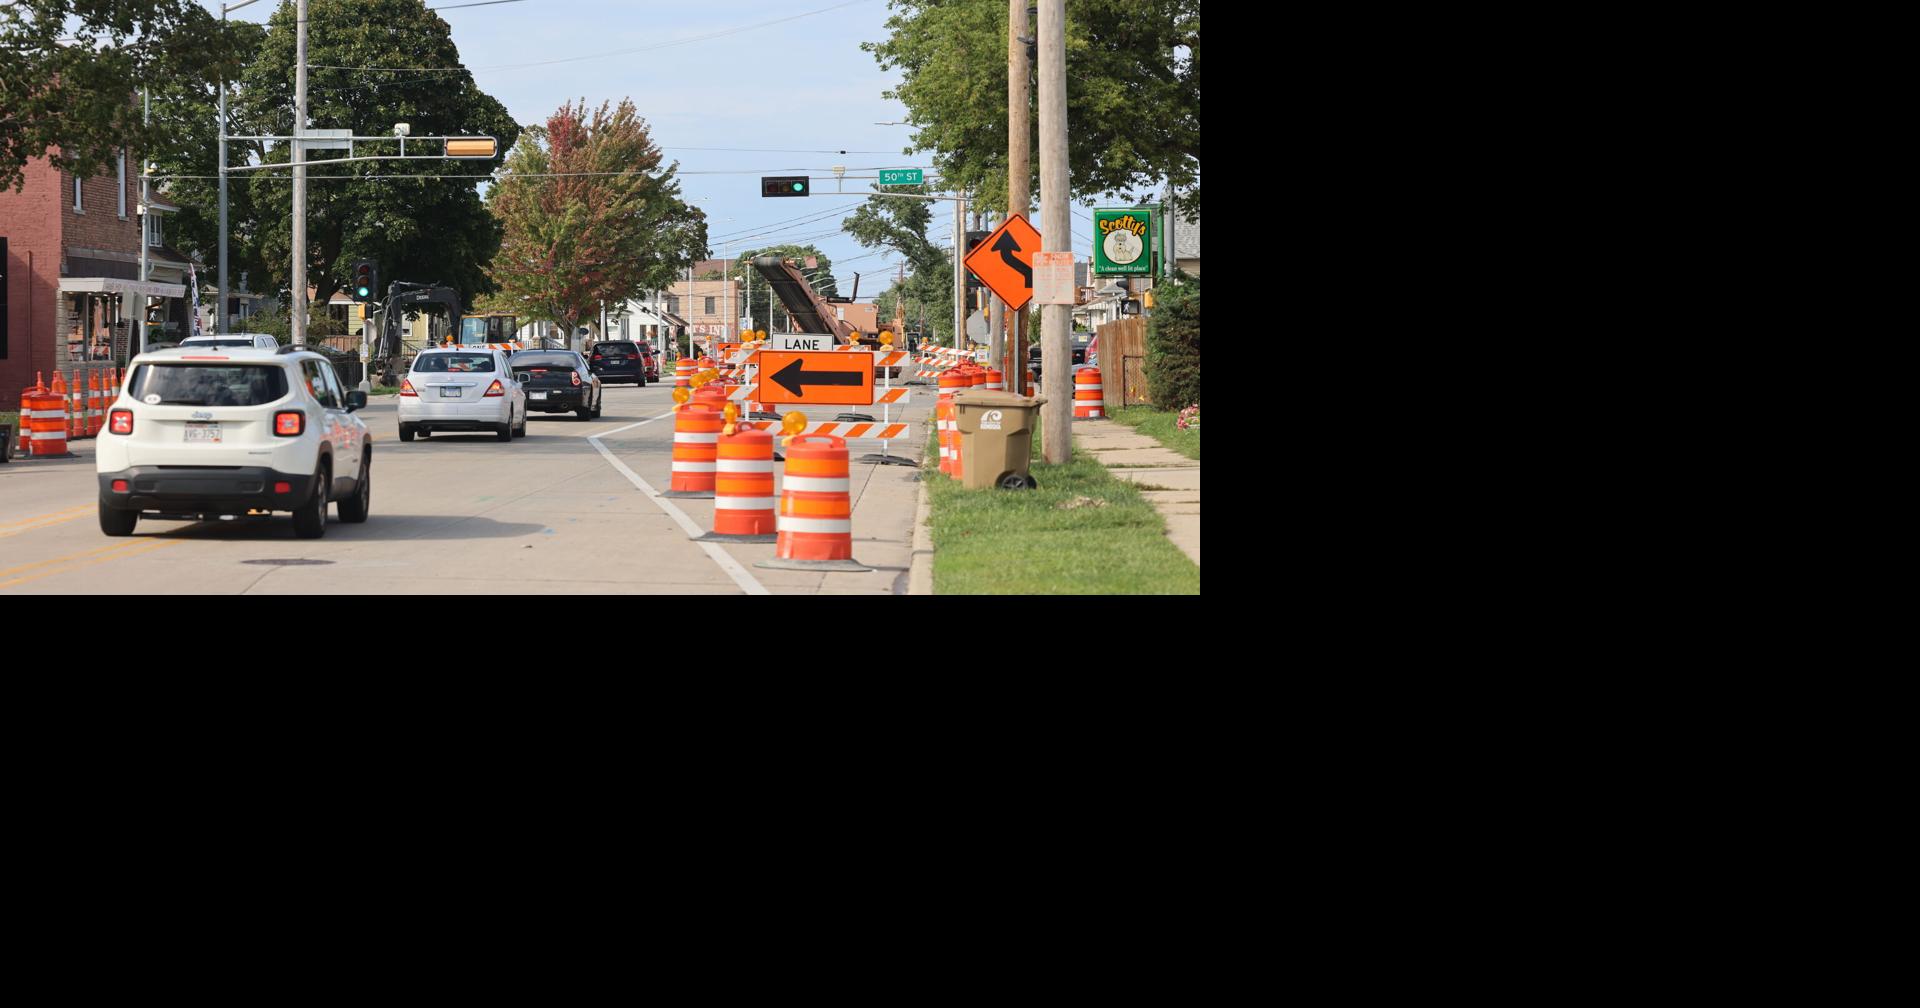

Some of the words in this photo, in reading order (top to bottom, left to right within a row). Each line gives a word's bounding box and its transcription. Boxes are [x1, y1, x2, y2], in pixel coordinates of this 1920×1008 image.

[884, 172, 904, 182] 50TH
[906, 172, 918, 181] ST
[1099, 214, 1147, 236] Scotty's
[784, 338, 820, 351] LANE
